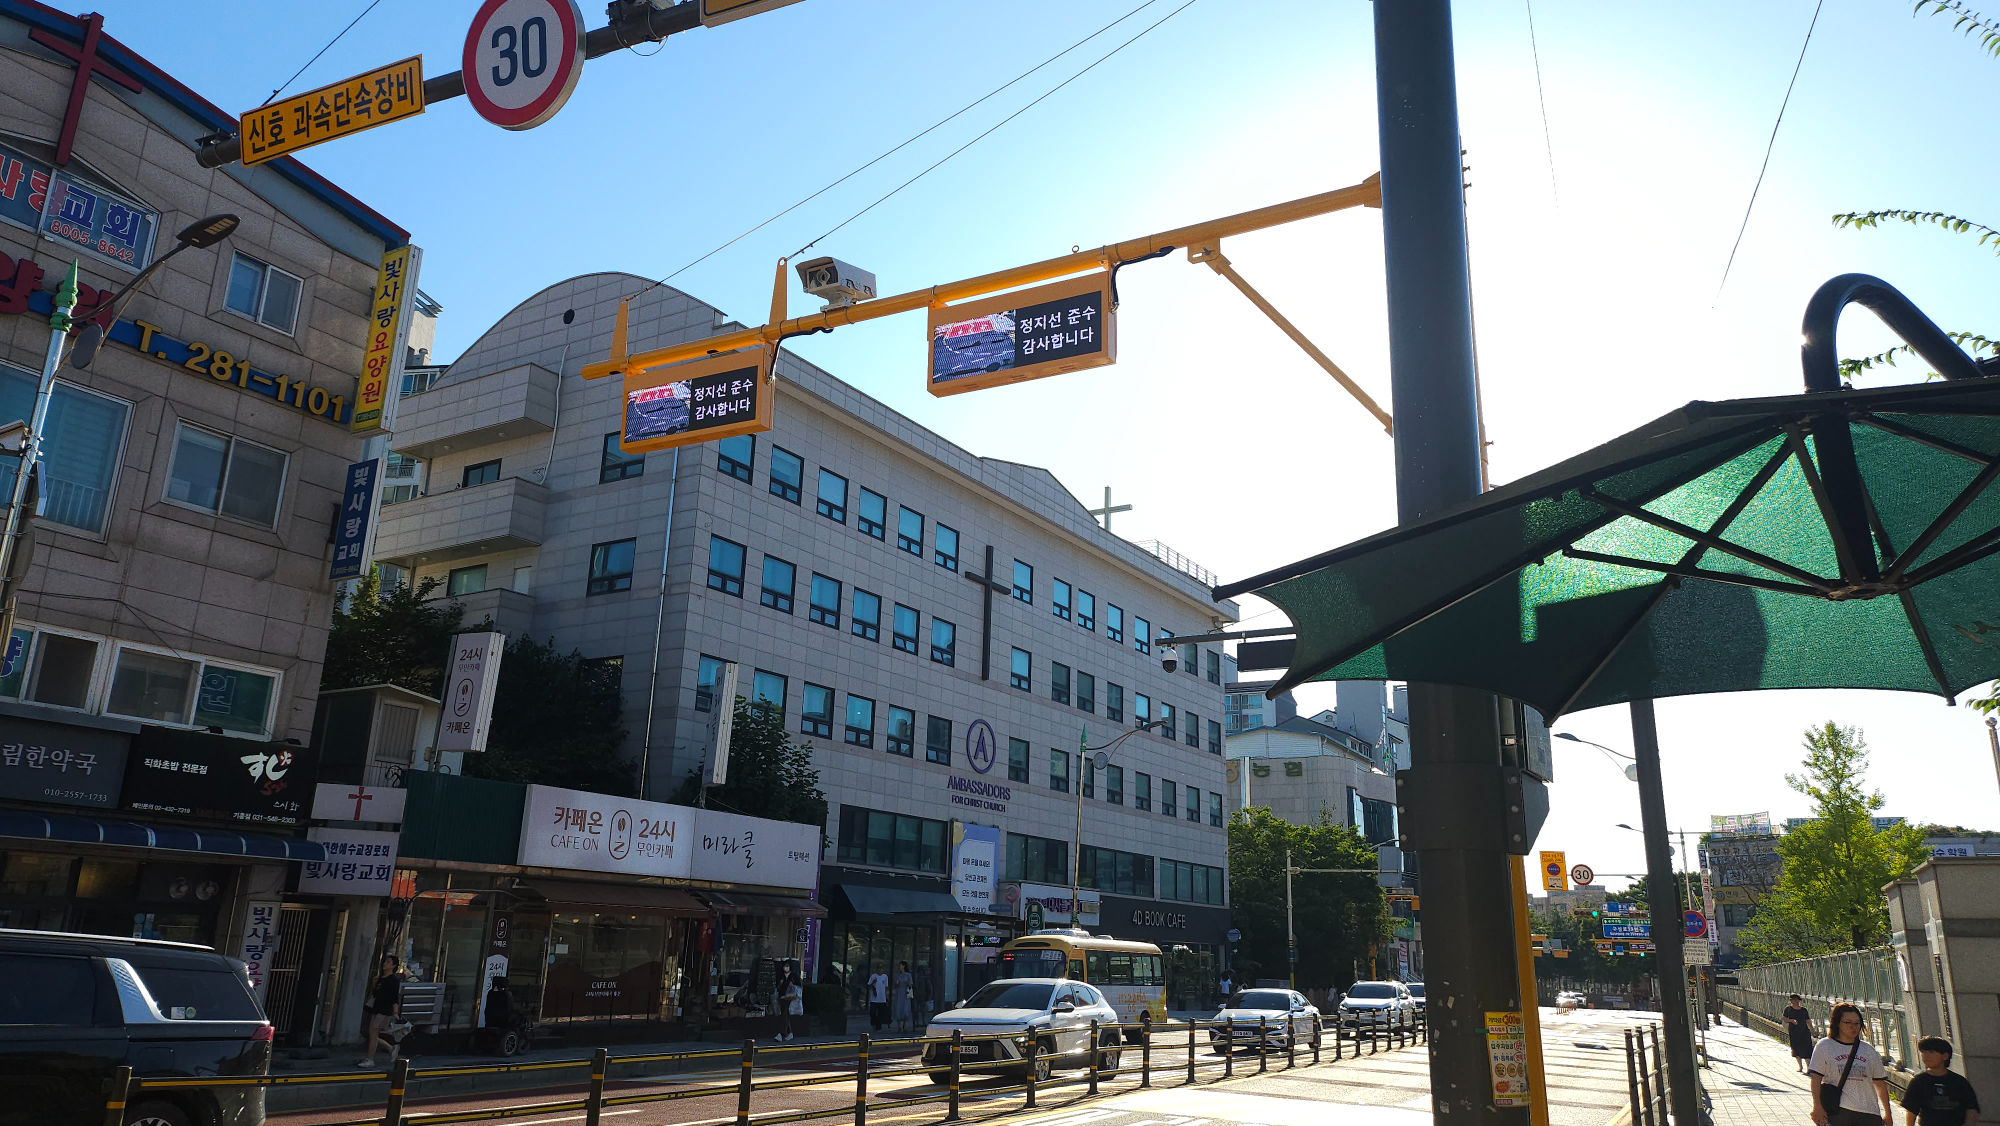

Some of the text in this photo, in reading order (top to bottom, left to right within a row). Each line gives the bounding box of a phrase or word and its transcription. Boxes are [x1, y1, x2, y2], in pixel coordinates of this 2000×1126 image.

[491, 16, 547, 87] 30
[248, 66, 415, 155] 신호 과속단속장비
[50, 219, 136, 264] 8005-8642
[362, 257, 403, 404] 빛사랑요양원
[1019, 305, 1096, 334] 정지선 준수
[1022, 326, 1095, 355] 감사합니다
[184, 341, 345, 422] 281-1101
[693, 378, 754, 402] 정지선 준수
[695, 397, 751, 421] 감사합니다
[460, 647, 483, 661] 24시
[200, 672, 236, 715] 원
[446, 721, 471, 734] 카페온
[144, 757, 209, 775] 직화초밥 전문점
[1252, 761, 1303, 778] 농협
[44, 788, 108, 802] 010-2557-1733
[946, 775, 1011, 801] AMBASSADORS
[951, 795, 1006, 812] FOR CHRIST CHURCH
[554, 807, 603, 834] 카페온
[638, 818, 676, 843] 24시
[551, 834, 599, 851] CAFE ON
[636, 841, 674, 860] 무인카페
[703, 831, 755, 869] 미라클
[306, 861, 391, 882] 빛사랑교회
[1574, 869, 1590, 880] 30
[1132, 909, 1186, 929] 4D BOOK CAFE
[591, 981, 607, 989] CAFE
